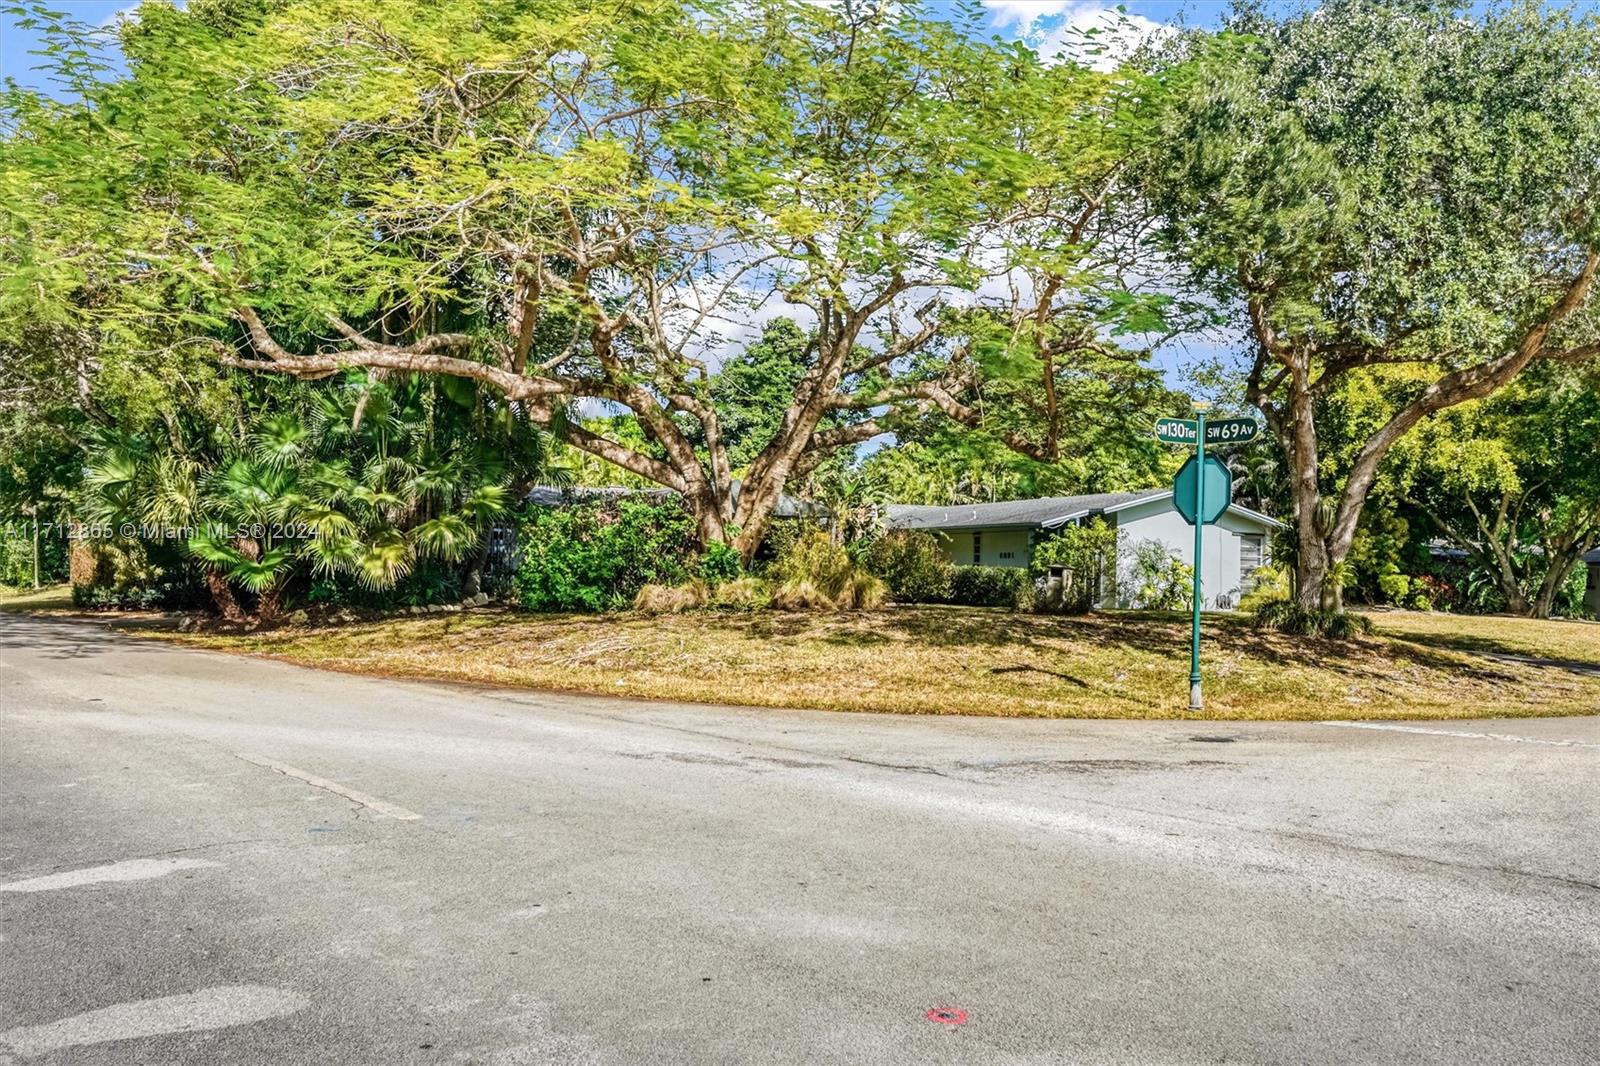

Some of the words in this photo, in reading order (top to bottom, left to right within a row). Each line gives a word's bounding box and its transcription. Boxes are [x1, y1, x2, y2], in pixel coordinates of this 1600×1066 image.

[1157, 424, 1168, 435] SW
[1168, 422, 1185, 438] 130
[1185, 427, 1196, 438] Ter
[1207, 427, 1220, 438] SW
[1221, 423, 1239, 438] 69
[1240, 424, 1253, 435] Av
